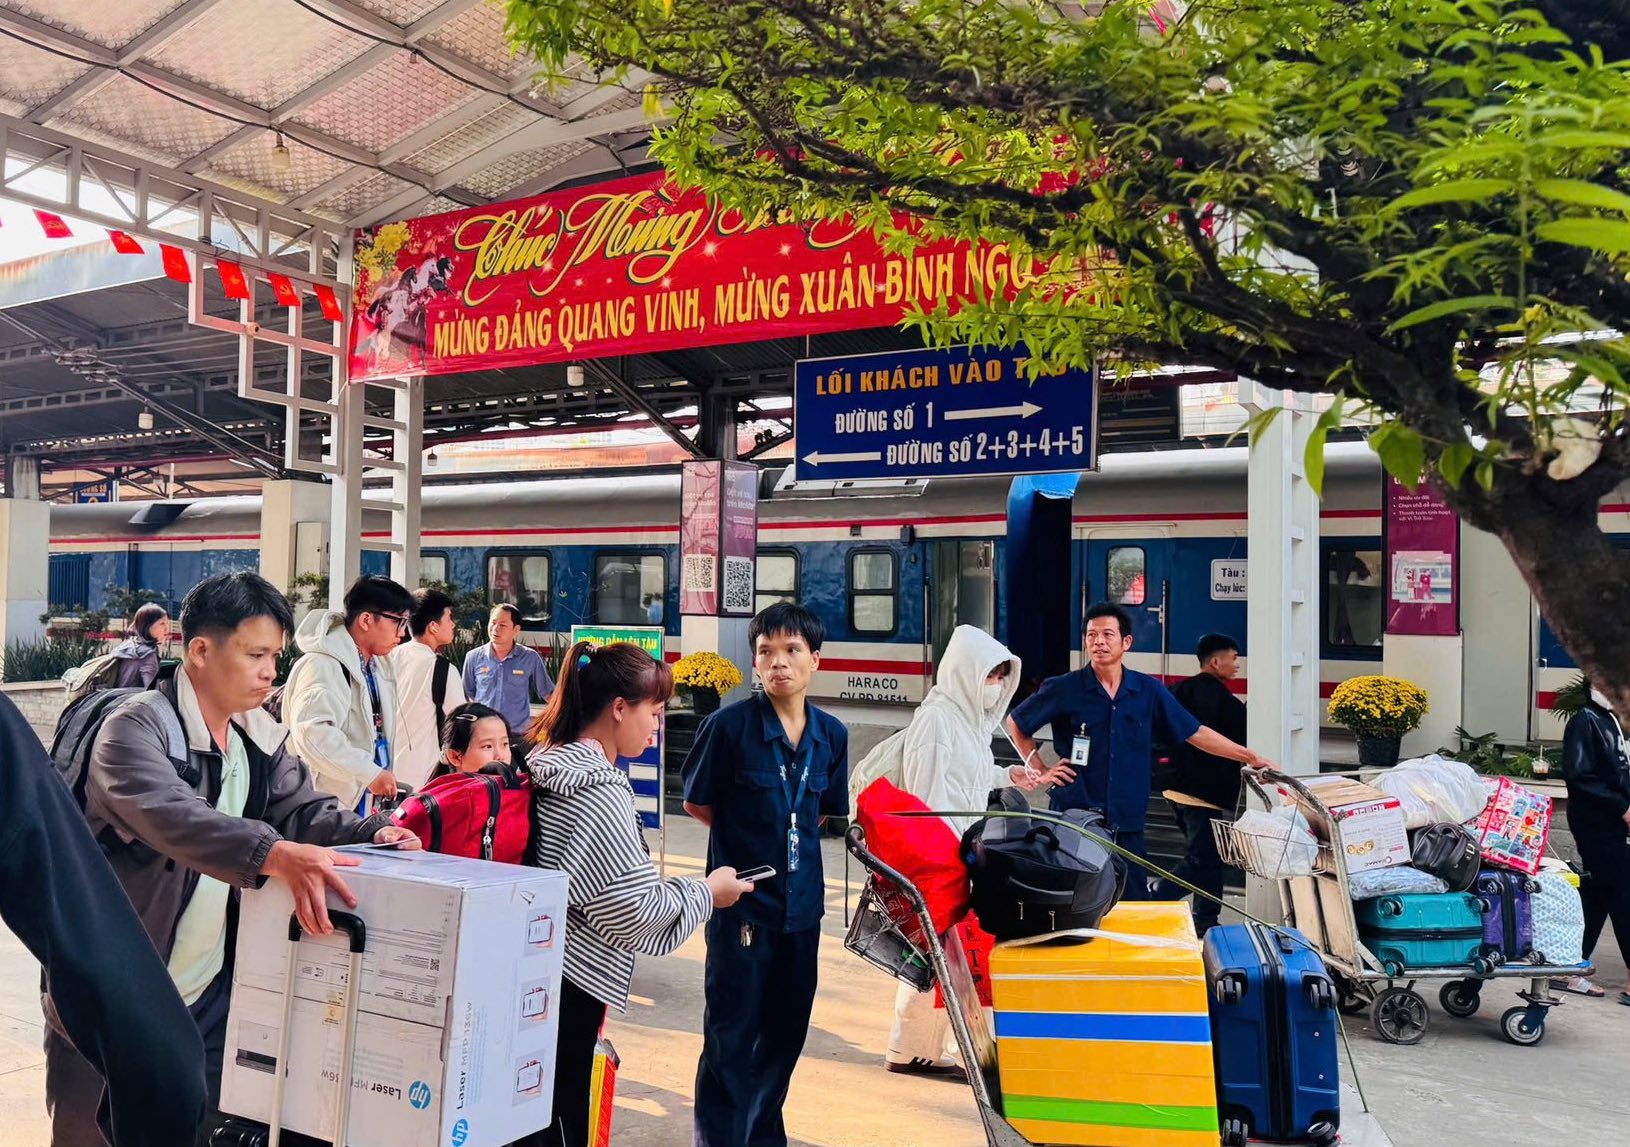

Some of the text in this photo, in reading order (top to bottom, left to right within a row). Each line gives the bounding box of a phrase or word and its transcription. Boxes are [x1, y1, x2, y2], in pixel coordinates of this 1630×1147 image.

[454, 206, 564, 306] Chúc
[529, 190, 717, 296] Mừng
[433, 308, 490, 359] MỪNG
[494, 299, 552, 351] ĐẢNG
[558, 301, 636, 353] QUANG
[644, 287, 705, 335] VINH,
[714, 266, 791, 328] MỪNG
[798, 251, 876, 316] XUÂN
[815, 366, 852, 396] LỐI
[860, 364, 939, 393] KHÁCH
[949, 356, 1002, 385] VÀO
[834, 401, 934, 434] ĐƯỜNG SỐ 1
[886, 425, 1084, 466] ĐƯỜNG SỐ 2+3+4+5
[1221, 567, 1239, 578] Tàu
[1215, 582, 1231, 594] Chạy
[641, 636, 657, 650] TÀU
[847, 676, 898, 690] HARACO
[350, 1077, 369, 1090] MF
[371, 1083, 401, 1100] Laser
[408, 1080, 432, 1110] hp
[456, 1070, 466, 1110] Laser
[451, 1118, 469, 1147] hp
